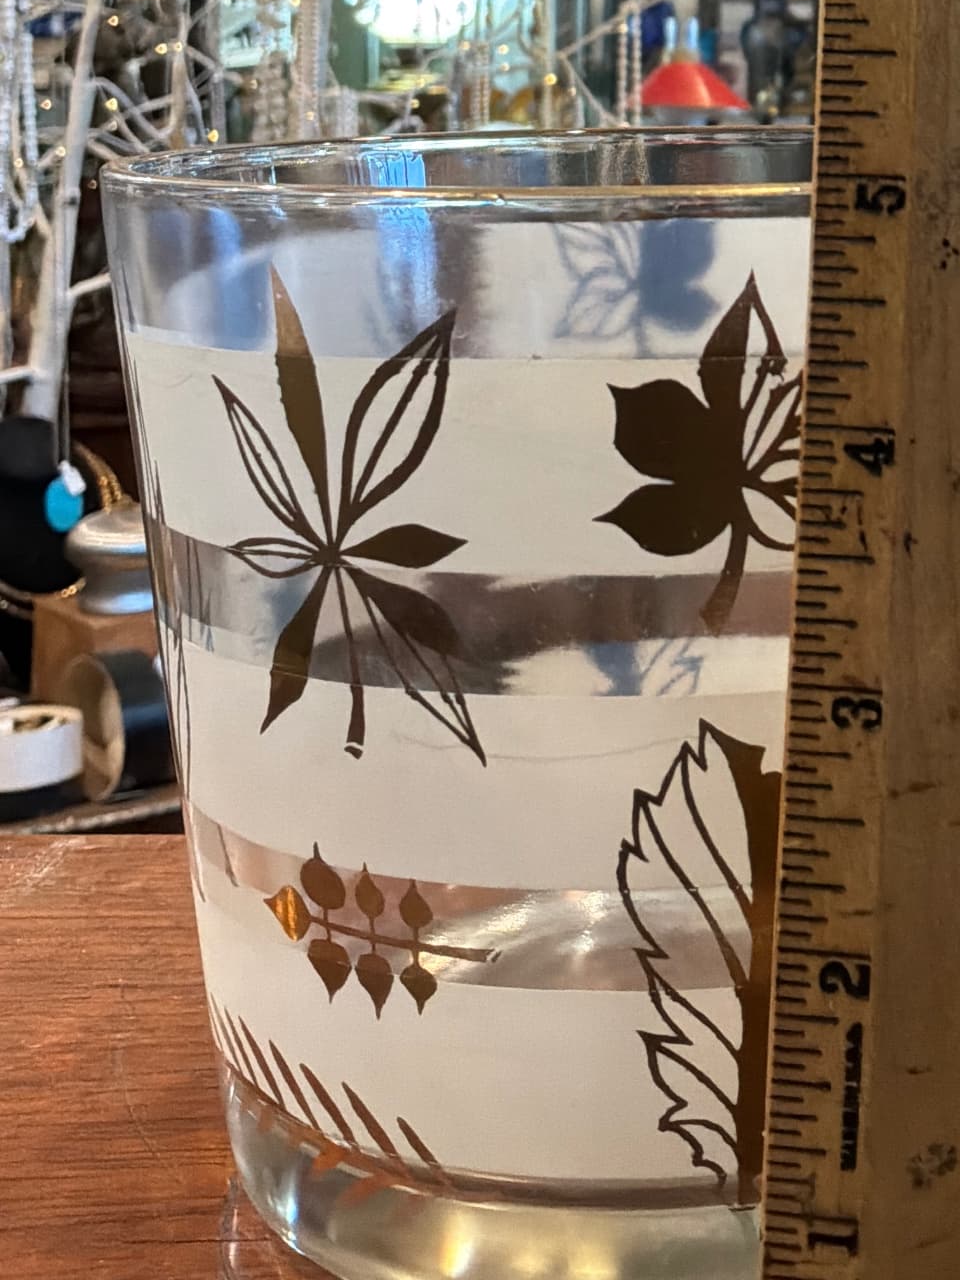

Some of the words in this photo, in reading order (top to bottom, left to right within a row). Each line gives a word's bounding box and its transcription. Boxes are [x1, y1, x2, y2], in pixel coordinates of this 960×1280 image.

[855, 183, 906, 216] 5
[844, 434, 895, 476] 4
[832, 696, 882, 732] 3
[820, 960, 871, 1000] 2
[807, 1222, 859, 1257] 1
